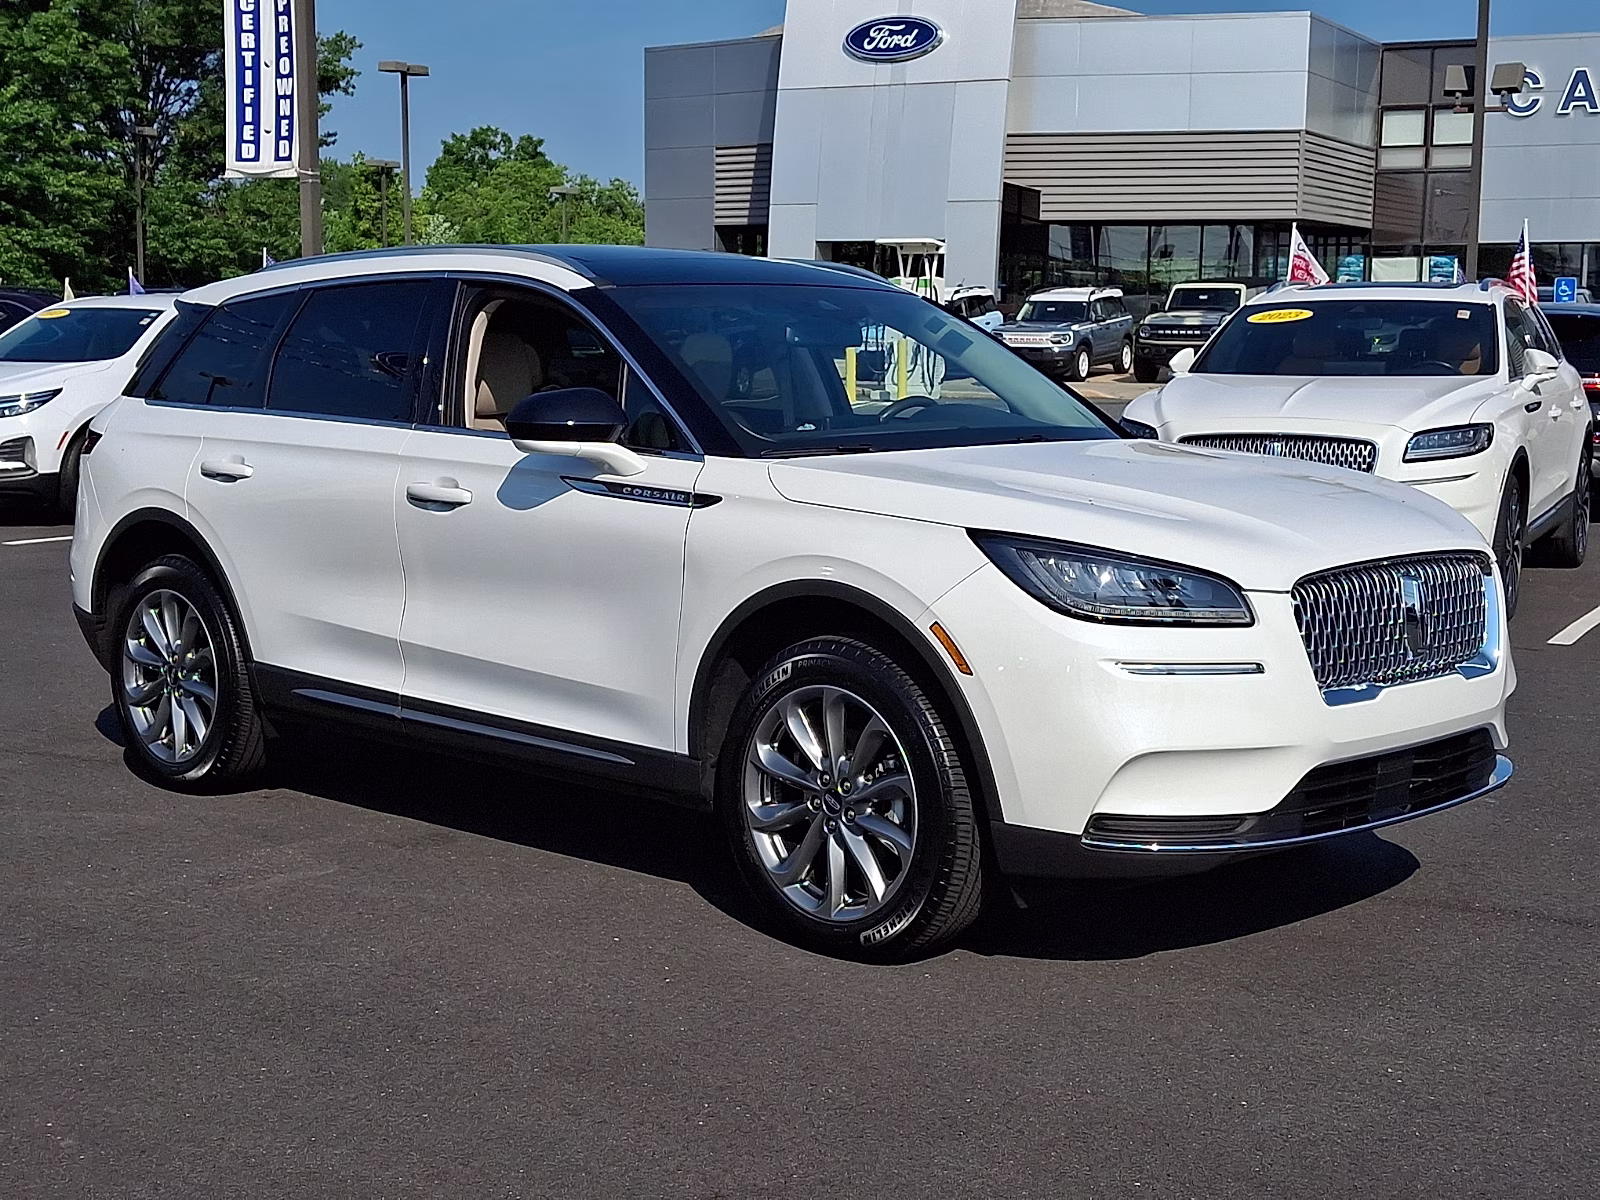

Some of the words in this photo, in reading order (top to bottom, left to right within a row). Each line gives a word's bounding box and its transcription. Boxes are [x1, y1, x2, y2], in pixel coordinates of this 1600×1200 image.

[863, 24, 919, 50] Ford
[239, 0, 256, 159] CERTIFIED
[276, 0, 293, 158] PREOWNED
[1500, 67, 1600, 117] CA
[622, 486, 686, 502] CORSAIR
